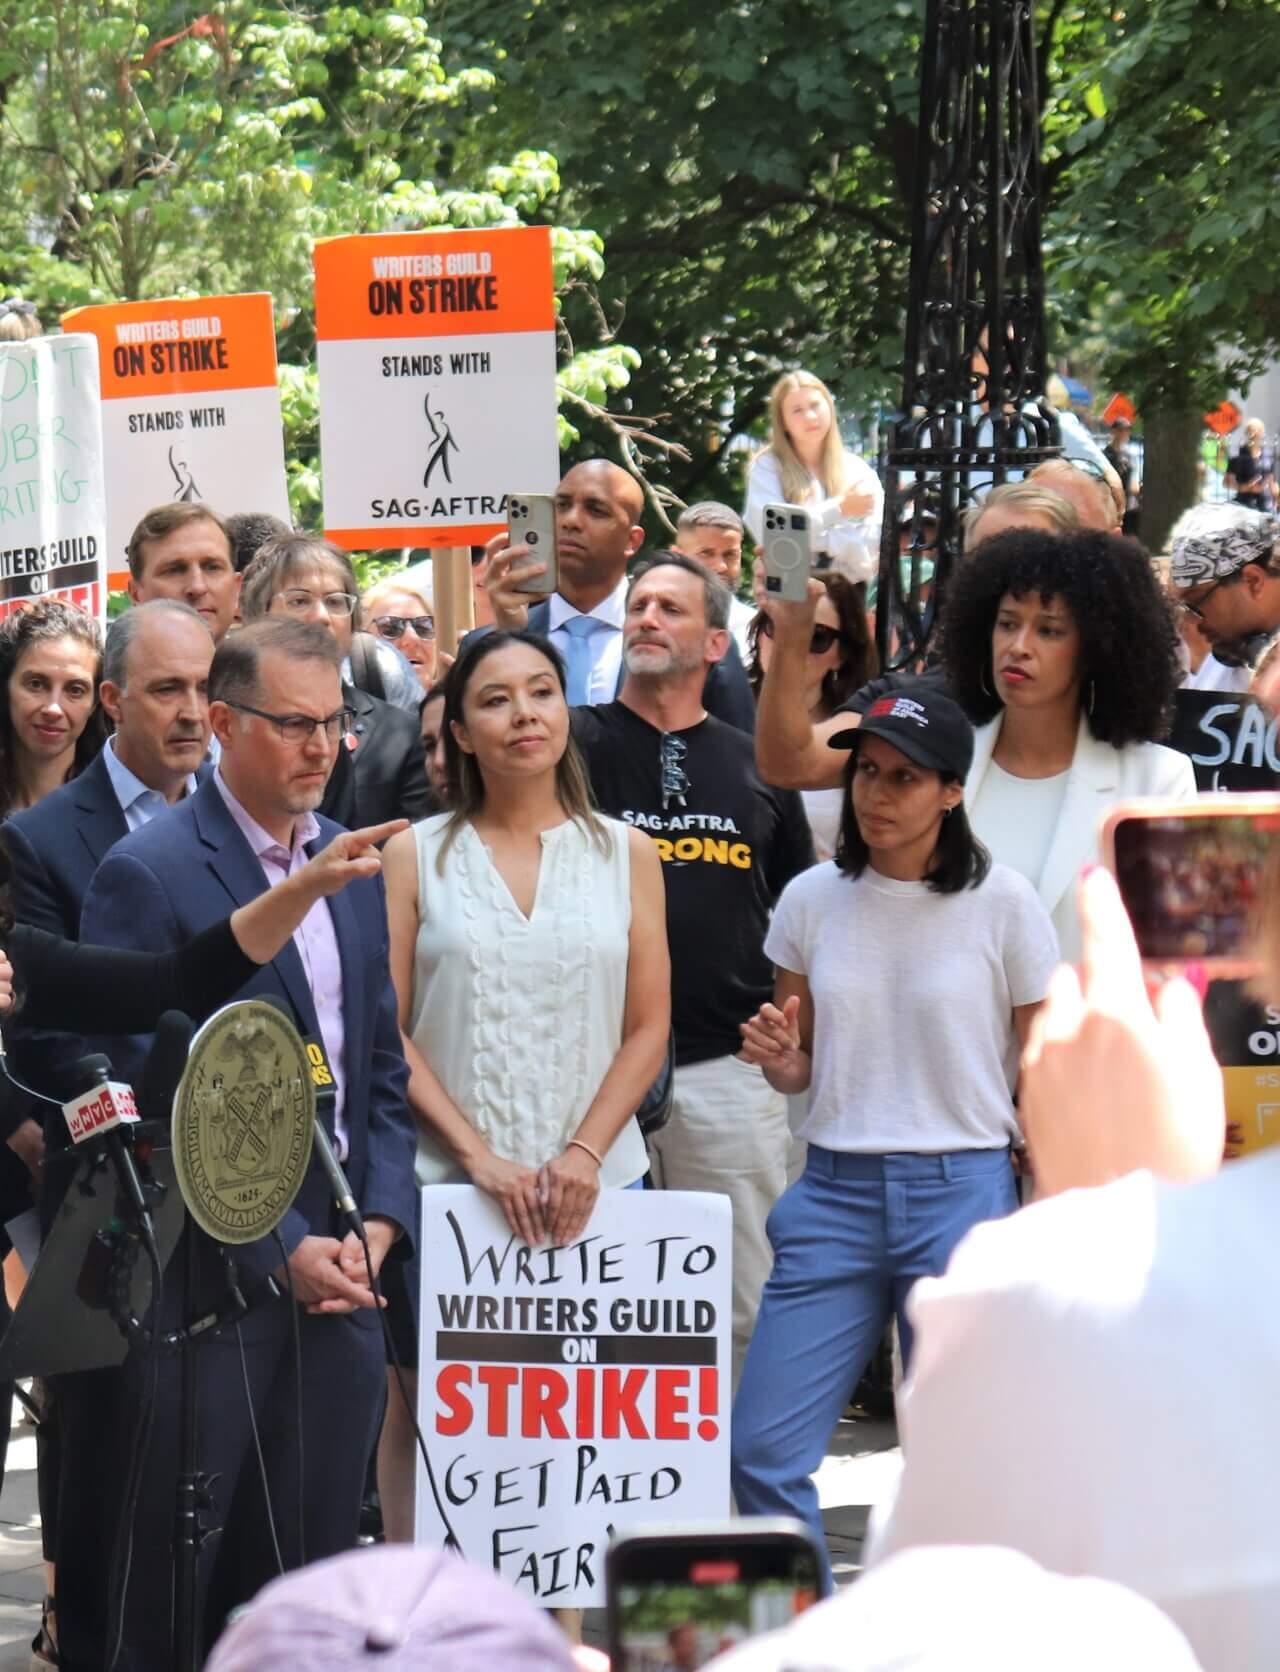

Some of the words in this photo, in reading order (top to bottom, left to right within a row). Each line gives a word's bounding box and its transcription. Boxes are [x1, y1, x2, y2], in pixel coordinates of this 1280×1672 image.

[373, 255, 443, 280] WRITERS
[446, 252, 492, 276] GUILD
[368, 280, 404, 316] ON
[409, 276, 498, 315] STRIKE
[115, 320, 181, 344] WRITERS
[182, 316, 222, 339] GUILD
[113, 346, 146, 378] ON
[151, 338, 229, 375] STRIKE
[382, 354, 443, 378] STANDS
[449, 352, 491, 375] WITH
[128, 410, 185, 433] STANDS
[190, 407, 226, 429] WITH
[49, 535, 97, 567] GUILD
[30, 573, 49, 594] ON
[652, 837, 752, 869] RONG
[70, 1094, 115, 1134] WNYC
[446, 1209, 626, 1286] WRITE
[645, 1236, 717, 1285] TO
[437, 1294, 598, 1333] WRITERS
[610, 1299, 717, 1334] GUILD
[562, 1337, 597, 1363] ON
[435, 1363, 719, 1442] STRIKE!
[444, 1454, 554, 1508] GET
[575, 1445, 682, 1505] PAID
